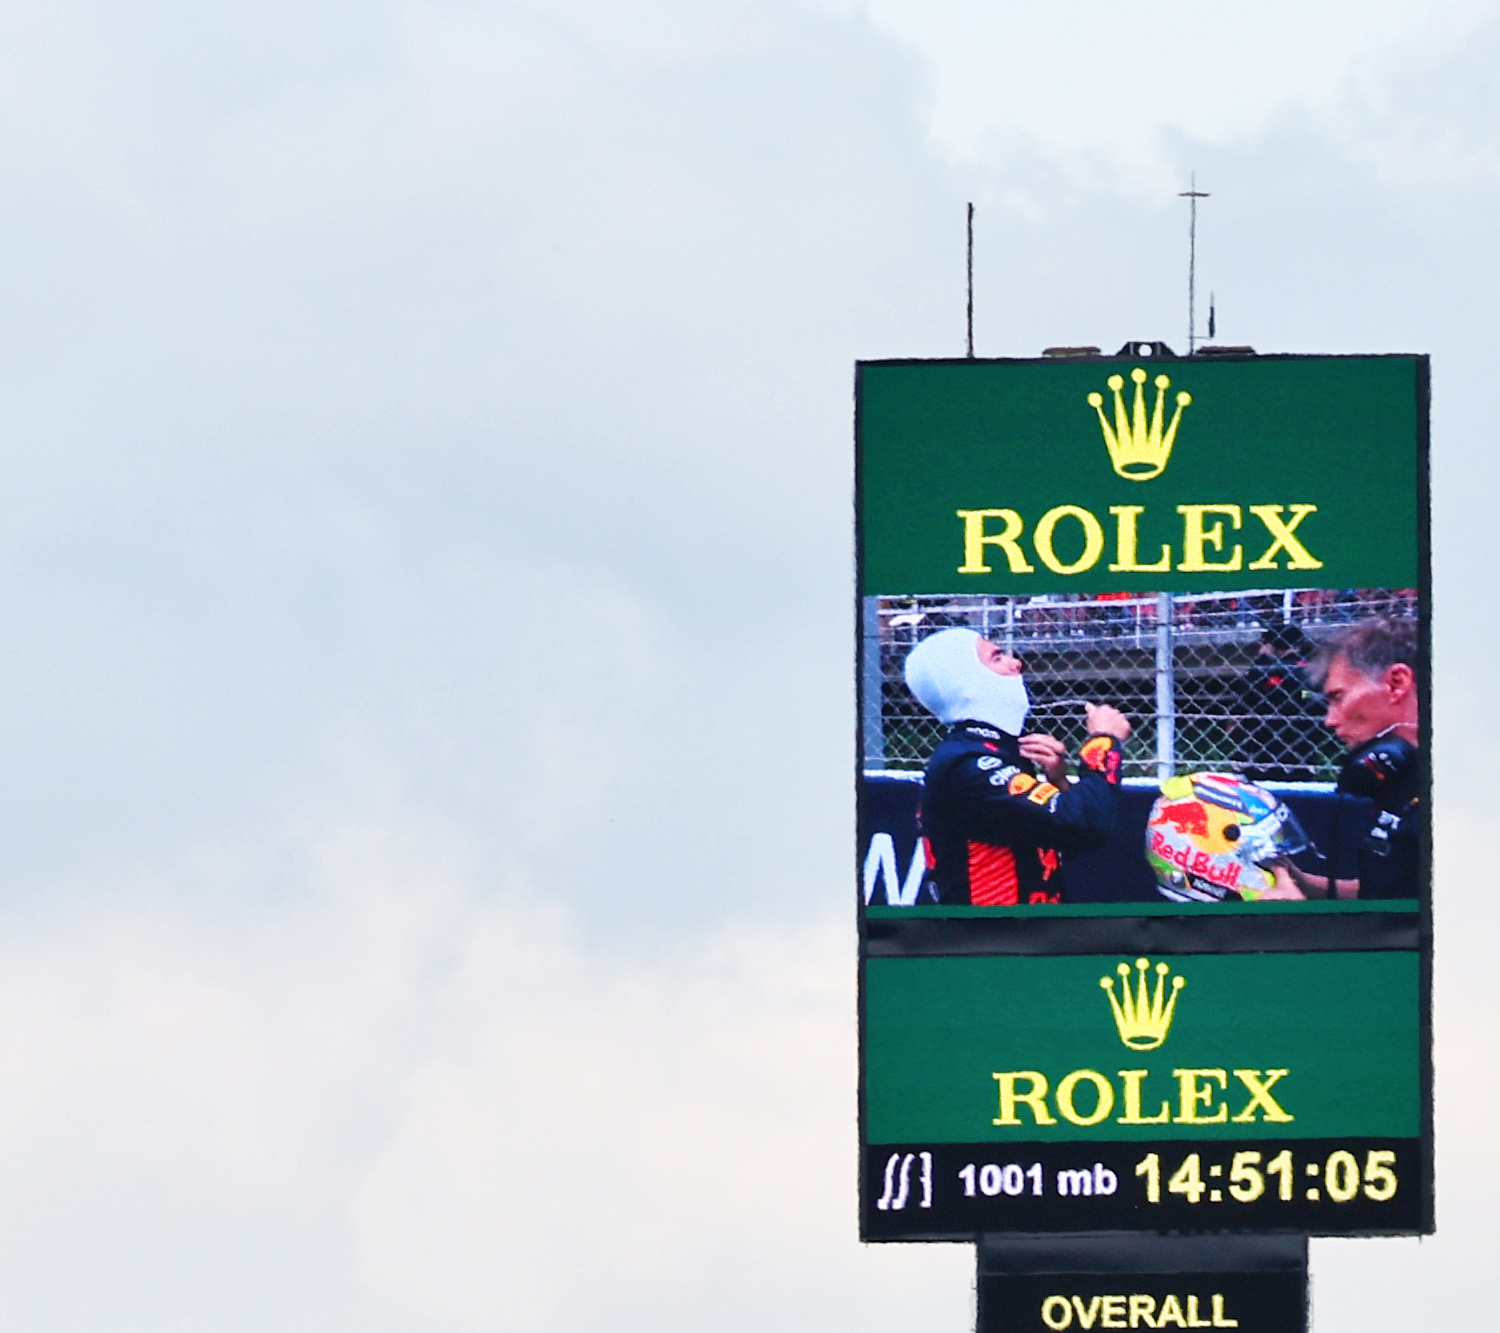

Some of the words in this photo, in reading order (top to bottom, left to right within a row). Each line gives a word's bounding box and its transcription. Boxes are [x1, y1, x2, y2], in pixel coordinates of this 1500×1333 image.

[957, 504, 1323, 574] ROLEX
[993, 1069, 1294, 1125] ROLEX
[959, 1163, 1042, 1196] 1001
[1057, 1163, 1117, 1196] mb
[1136, 1150, 1397, 1203] 14:51:05
[1042, 1294, 1238, 1330] OVERALL
